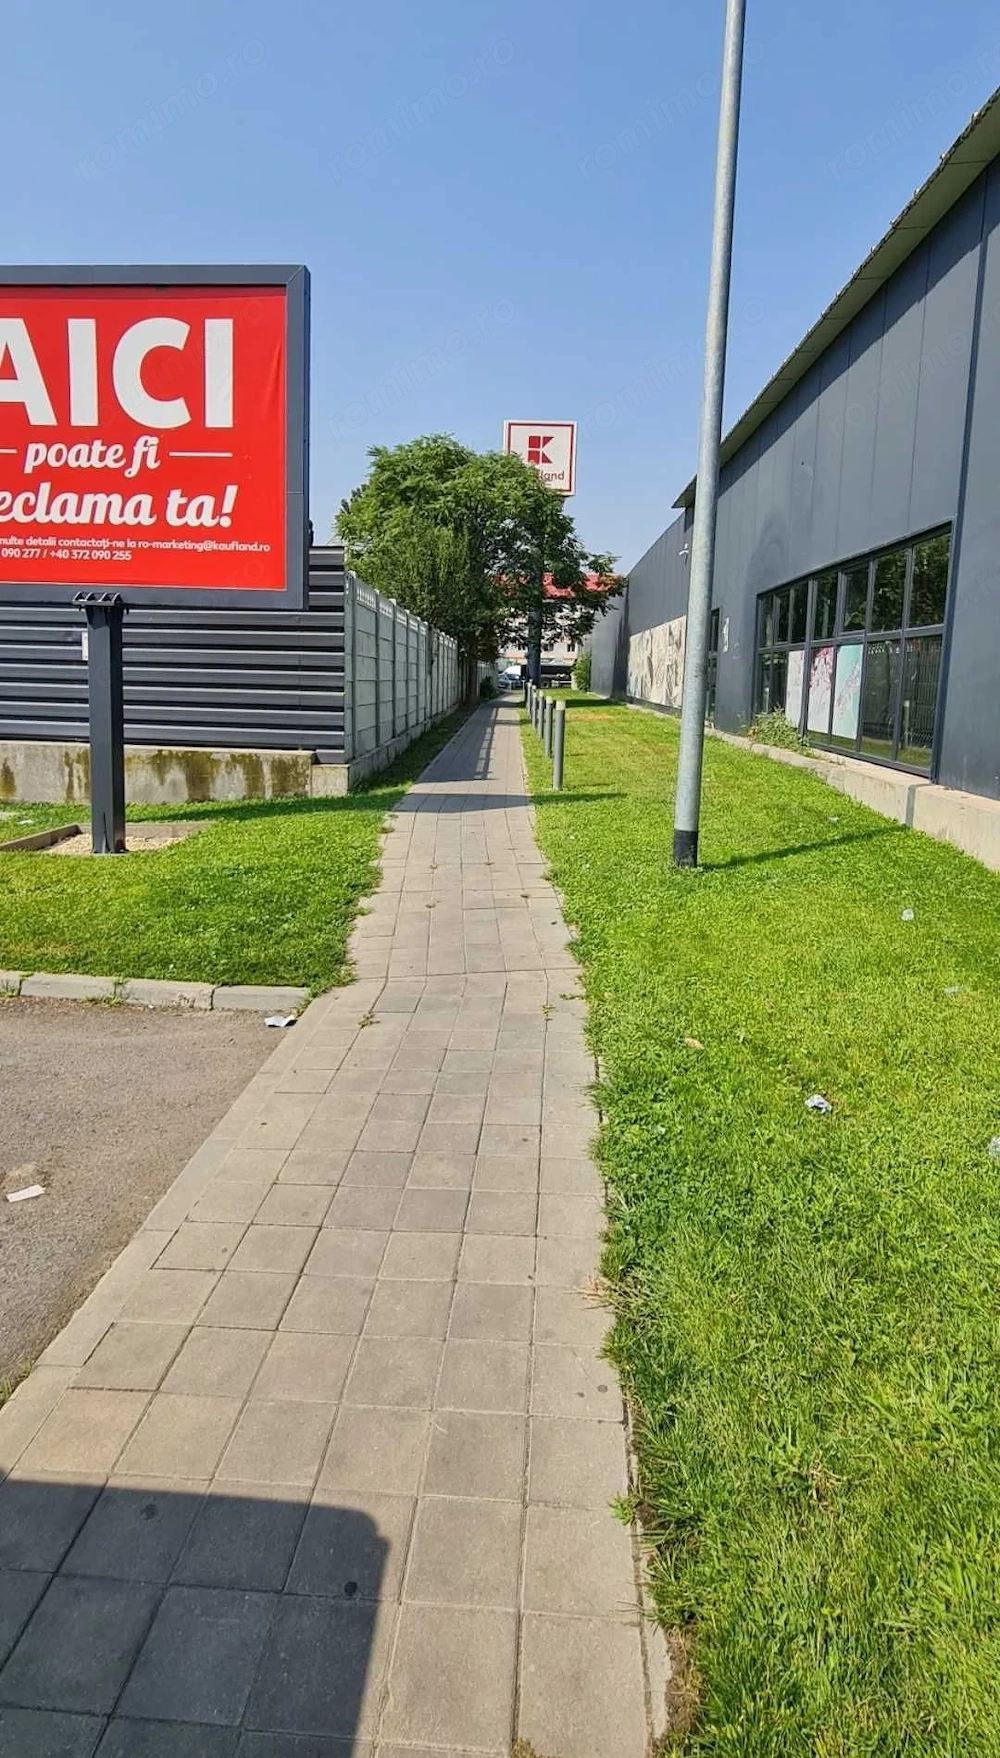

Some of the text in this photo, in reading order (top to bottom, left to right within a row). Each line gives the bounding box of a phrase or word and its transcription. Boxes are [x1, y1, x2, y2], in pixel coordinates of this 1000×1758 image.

[0, 317, 234, 429] AICI
[24, 435, 160, 478] poate fi
[0, 481, 238, 528] eclama ta!
[1, 547, 21, 558] 090
[22, 548, 41, 558] 277
[42, 549, 48, 558] /
[50, 549, 70, 559] +40
[71, 549, 90, 560] 372
[91, 550, 111, 560] 090
[26, 536, 57, 546] detalii
[127, 538, 136, 548] la
[138, 539, 271, 553] ro-marketing@kaufland.ro
